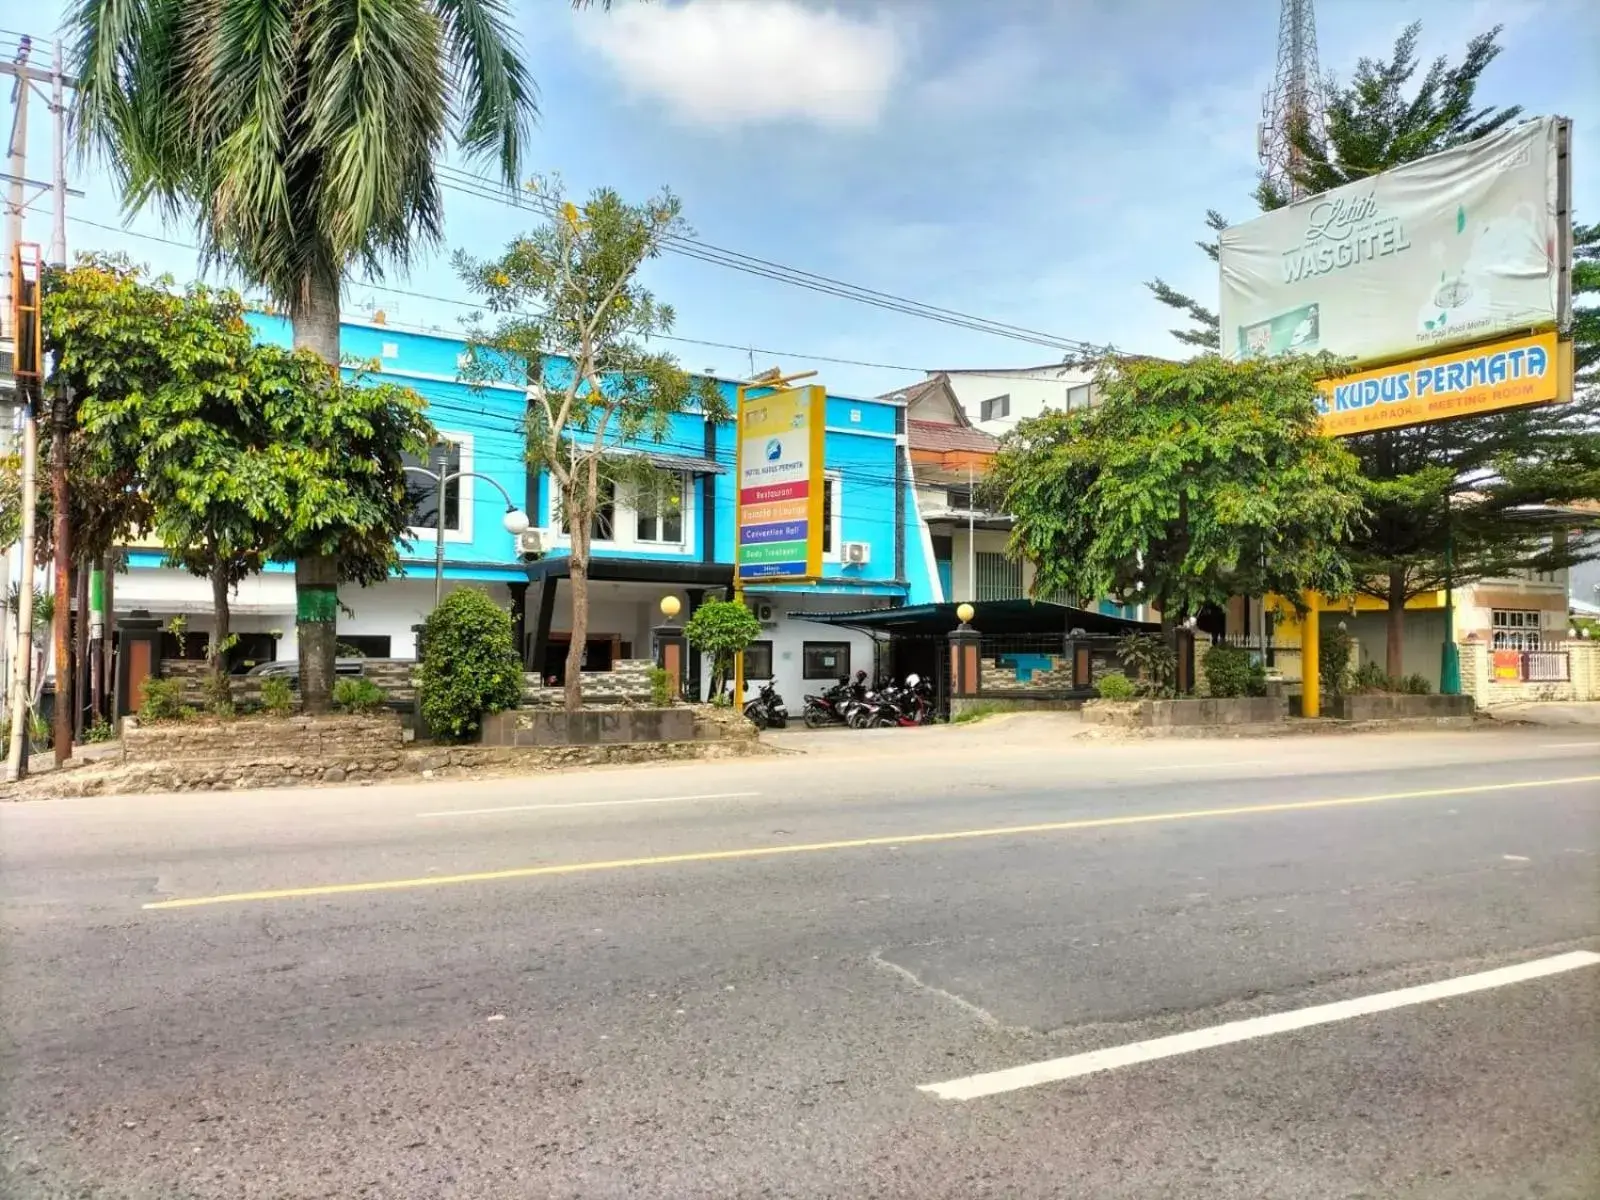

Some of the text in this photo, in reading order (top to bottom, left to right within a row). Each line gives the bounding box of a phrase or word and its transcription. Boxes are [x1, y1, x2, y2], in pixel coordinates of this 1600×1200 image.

[1283, 223, 1411, 285] WASGITEL
[1335, 371, 1411, 412] KUDUS
[1415, 344, 1548, 398] PERMATA
[1428, 392, 1487, 411] MEETING
[1492, 384, 1535, 400] ROOM
[755, 487, 793, 499] Restaurant
[746, 528, 783, 539] Convention
